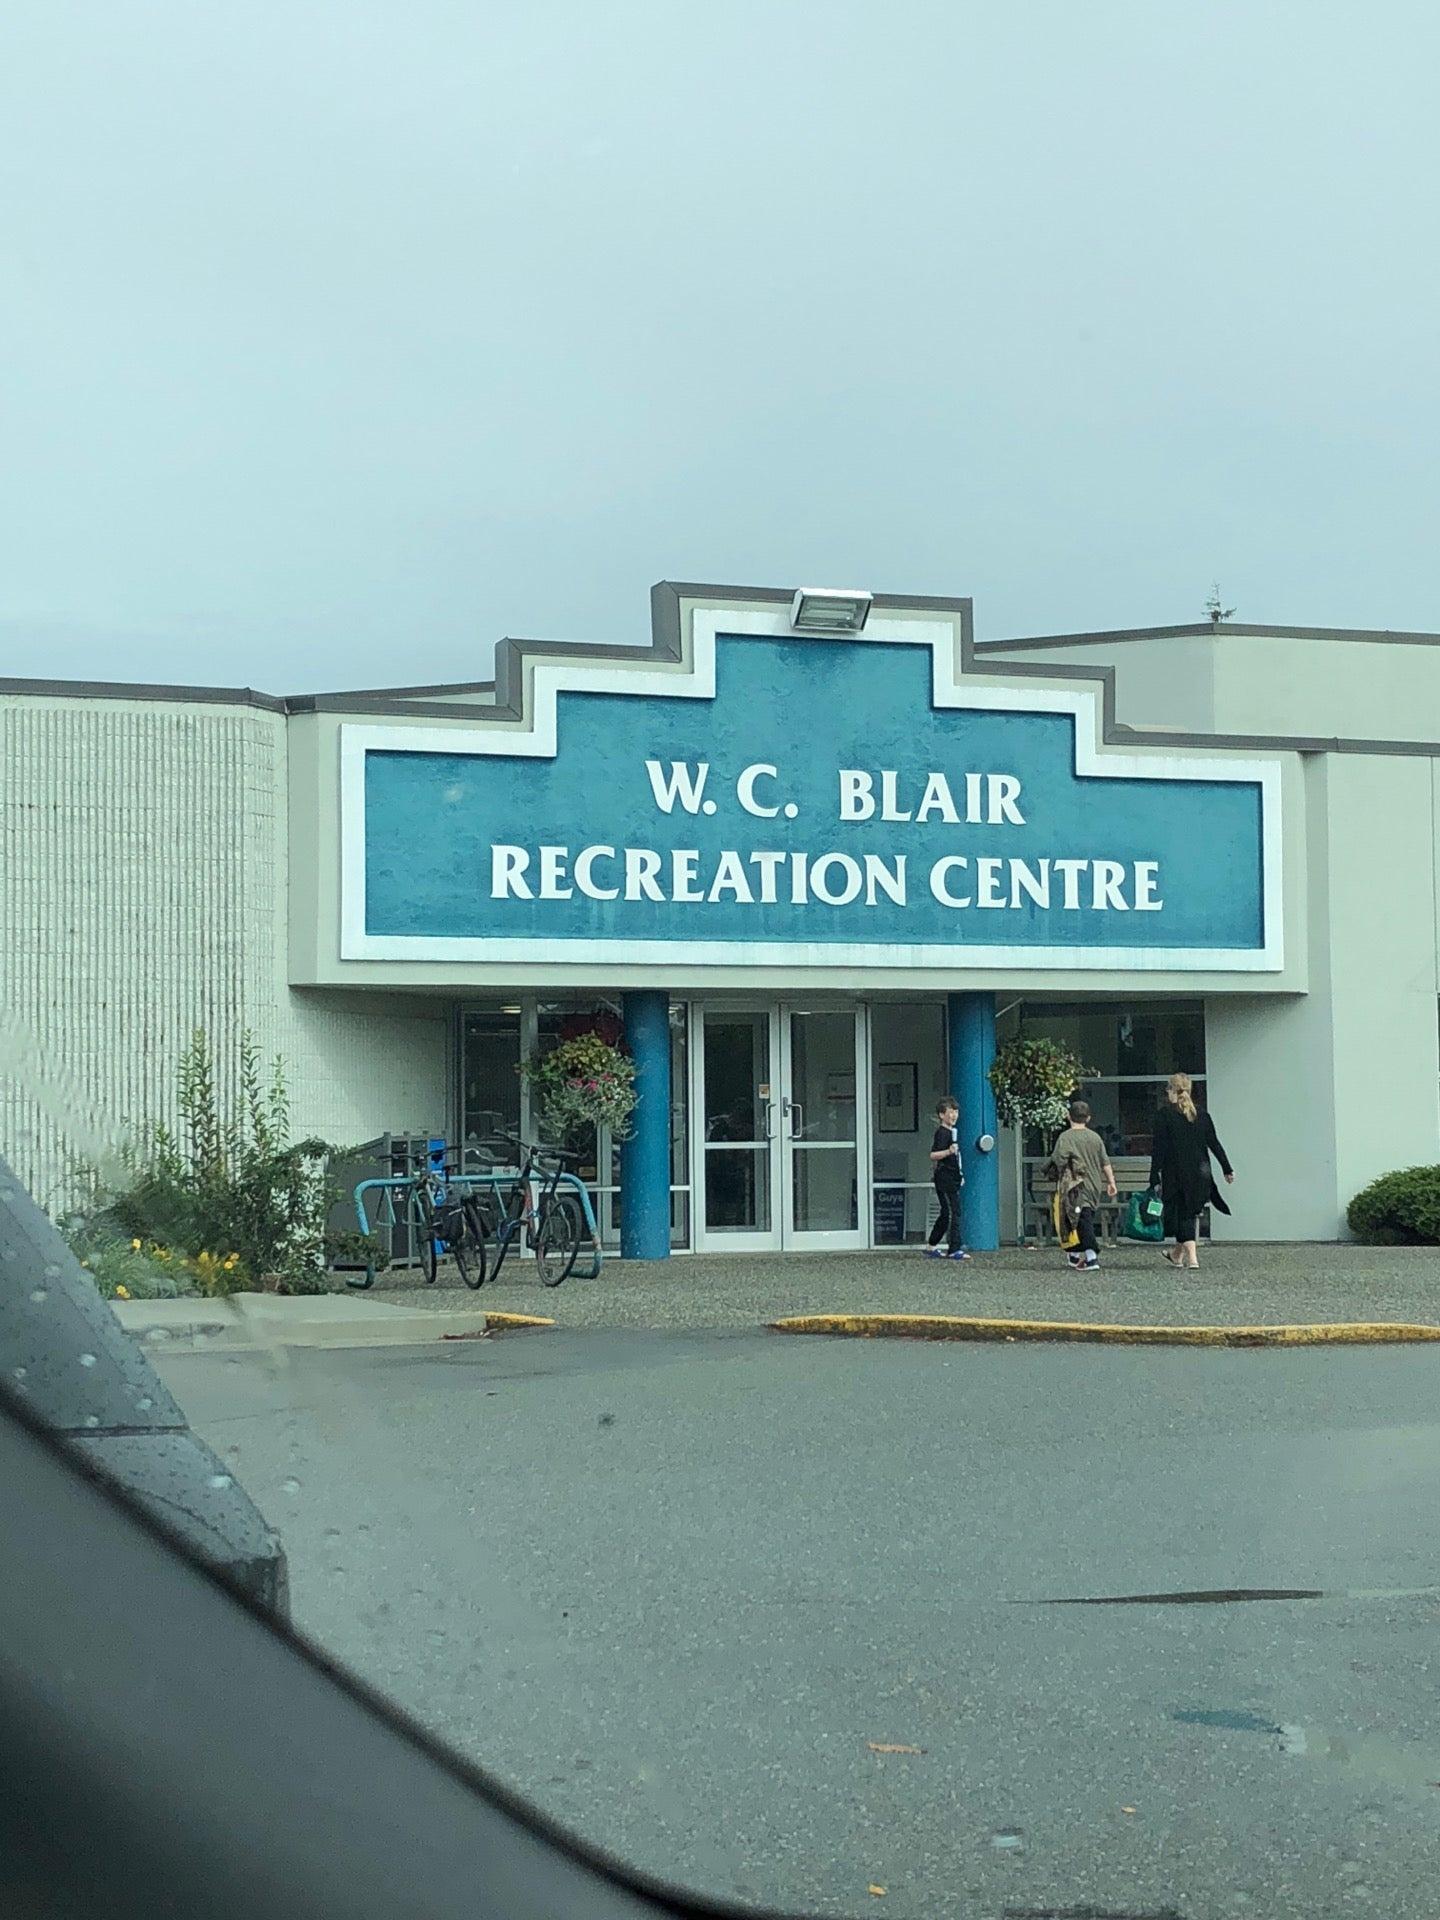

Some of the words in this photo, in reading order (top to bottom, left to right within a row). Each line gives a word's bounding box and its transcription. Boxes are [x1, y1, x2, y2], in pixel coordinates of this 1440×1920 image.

[645, 760, 717, 816] W.
[736, 763, 799, 819] C.
[838, 769, 1027, 825] BLAIR
[490, 844, 907, 907] RECREATION
[929, 855, 1164, 911] CENTRE
